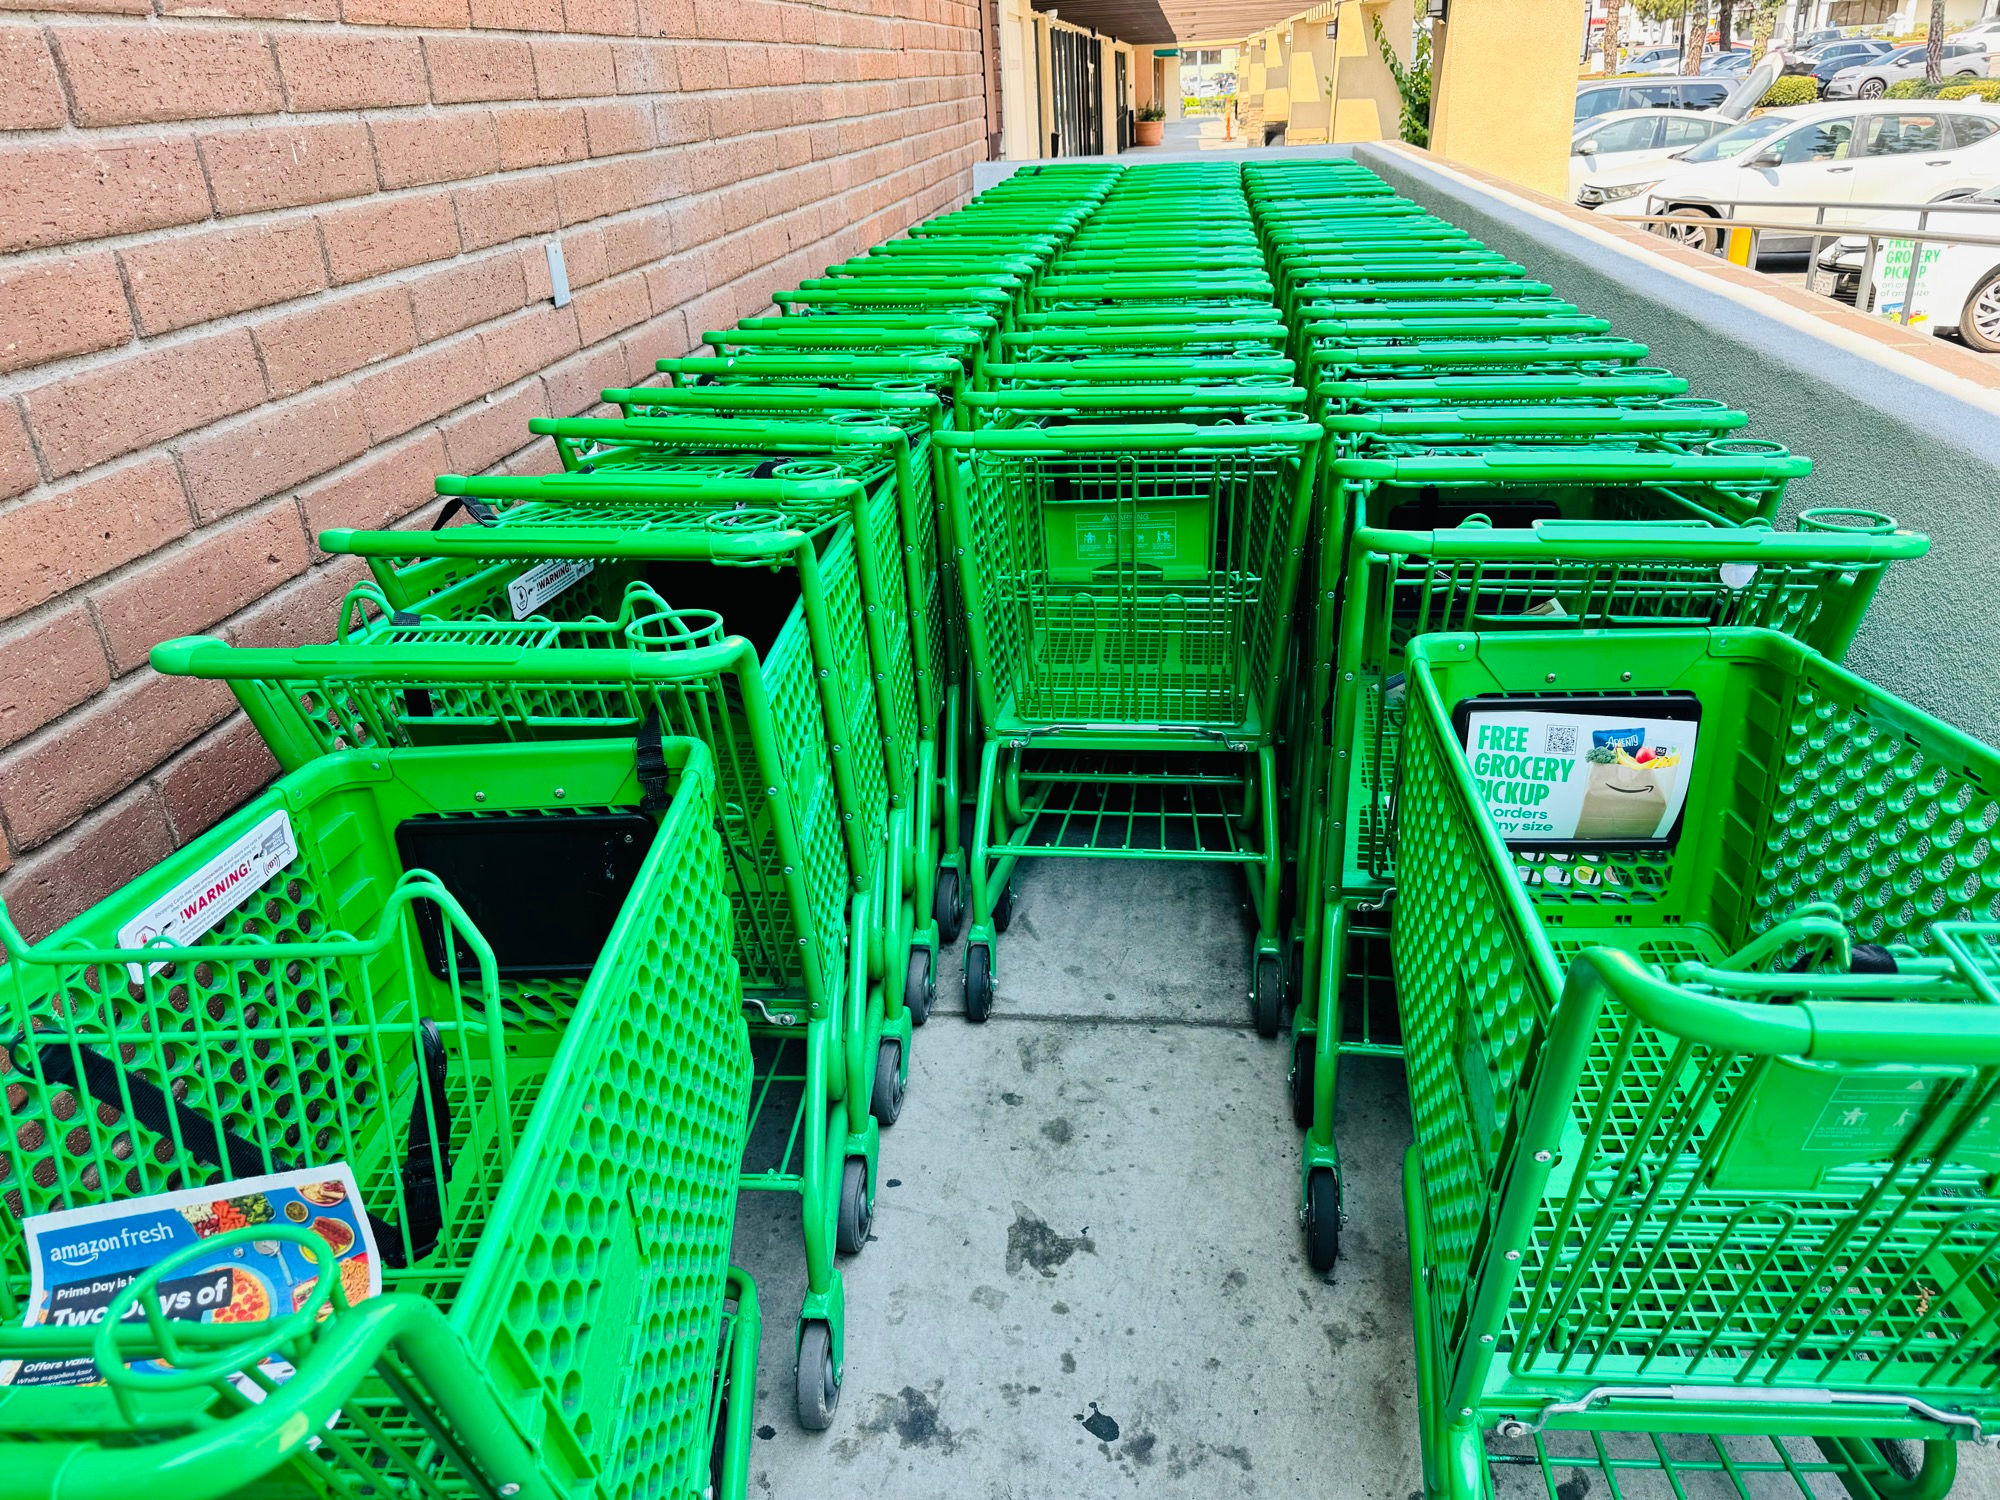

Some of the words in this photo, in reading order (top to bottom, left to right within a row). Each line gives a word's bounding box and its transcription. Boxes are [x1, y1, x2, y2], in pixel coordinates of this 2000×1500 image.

[1885, 249, 1941, 264] GROERY
[1883, 265, 1927, 279] PICKP
[1110, 513, 1150, 521] WARNG
[1477, 724, 1529, 753] FREE
[1474, 753, 1576, 783] GROCERY
[1493, 807, 1548, 820] orders
[1496, 821, 1520, 833] ny
[1521, 821, 1553, 832] size
[57, 1285, 91, 1301] Prime
[92, 1280, 116, 1297] Day
[117, 1277, 127, 1290] is
[53, 1306, 109, 1327] Two
[196, 1276, 228, 1305] of
[24, 1361, 63, 1373] Offers
[16, 1376, 40, 1385] While
[40, 1370, 76, 1382] supplies
[76, 1368, 93, 1376] last
[77, 1375, 97, 1383] only
